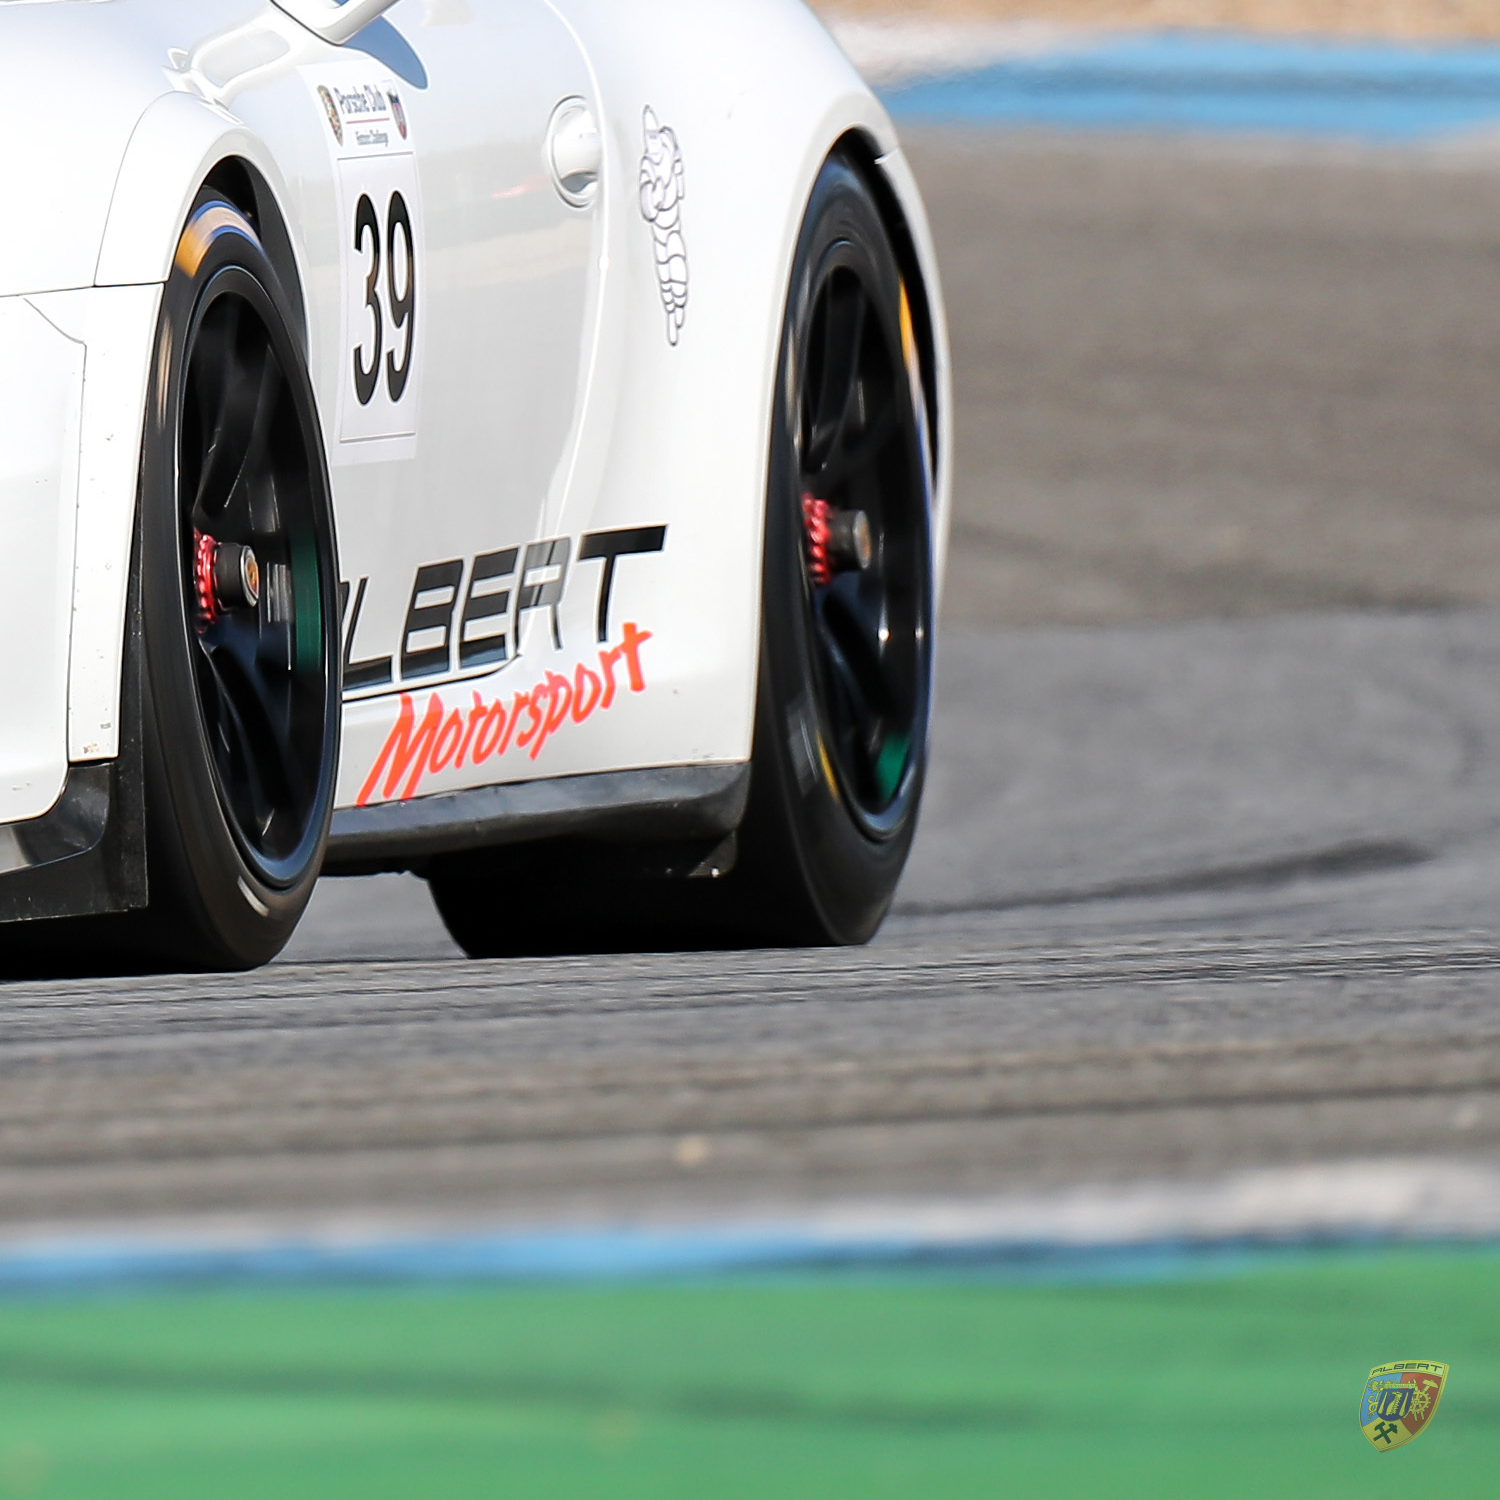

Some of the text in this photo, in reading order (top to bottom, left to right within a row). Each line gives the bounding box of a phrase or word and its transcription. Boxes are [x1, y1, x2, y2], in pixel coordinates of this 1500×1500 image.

[352, 189, 417, 406] 39
[340, 525, 668, 692] LBERT
[356, 621, 653, 808] Motorsport
